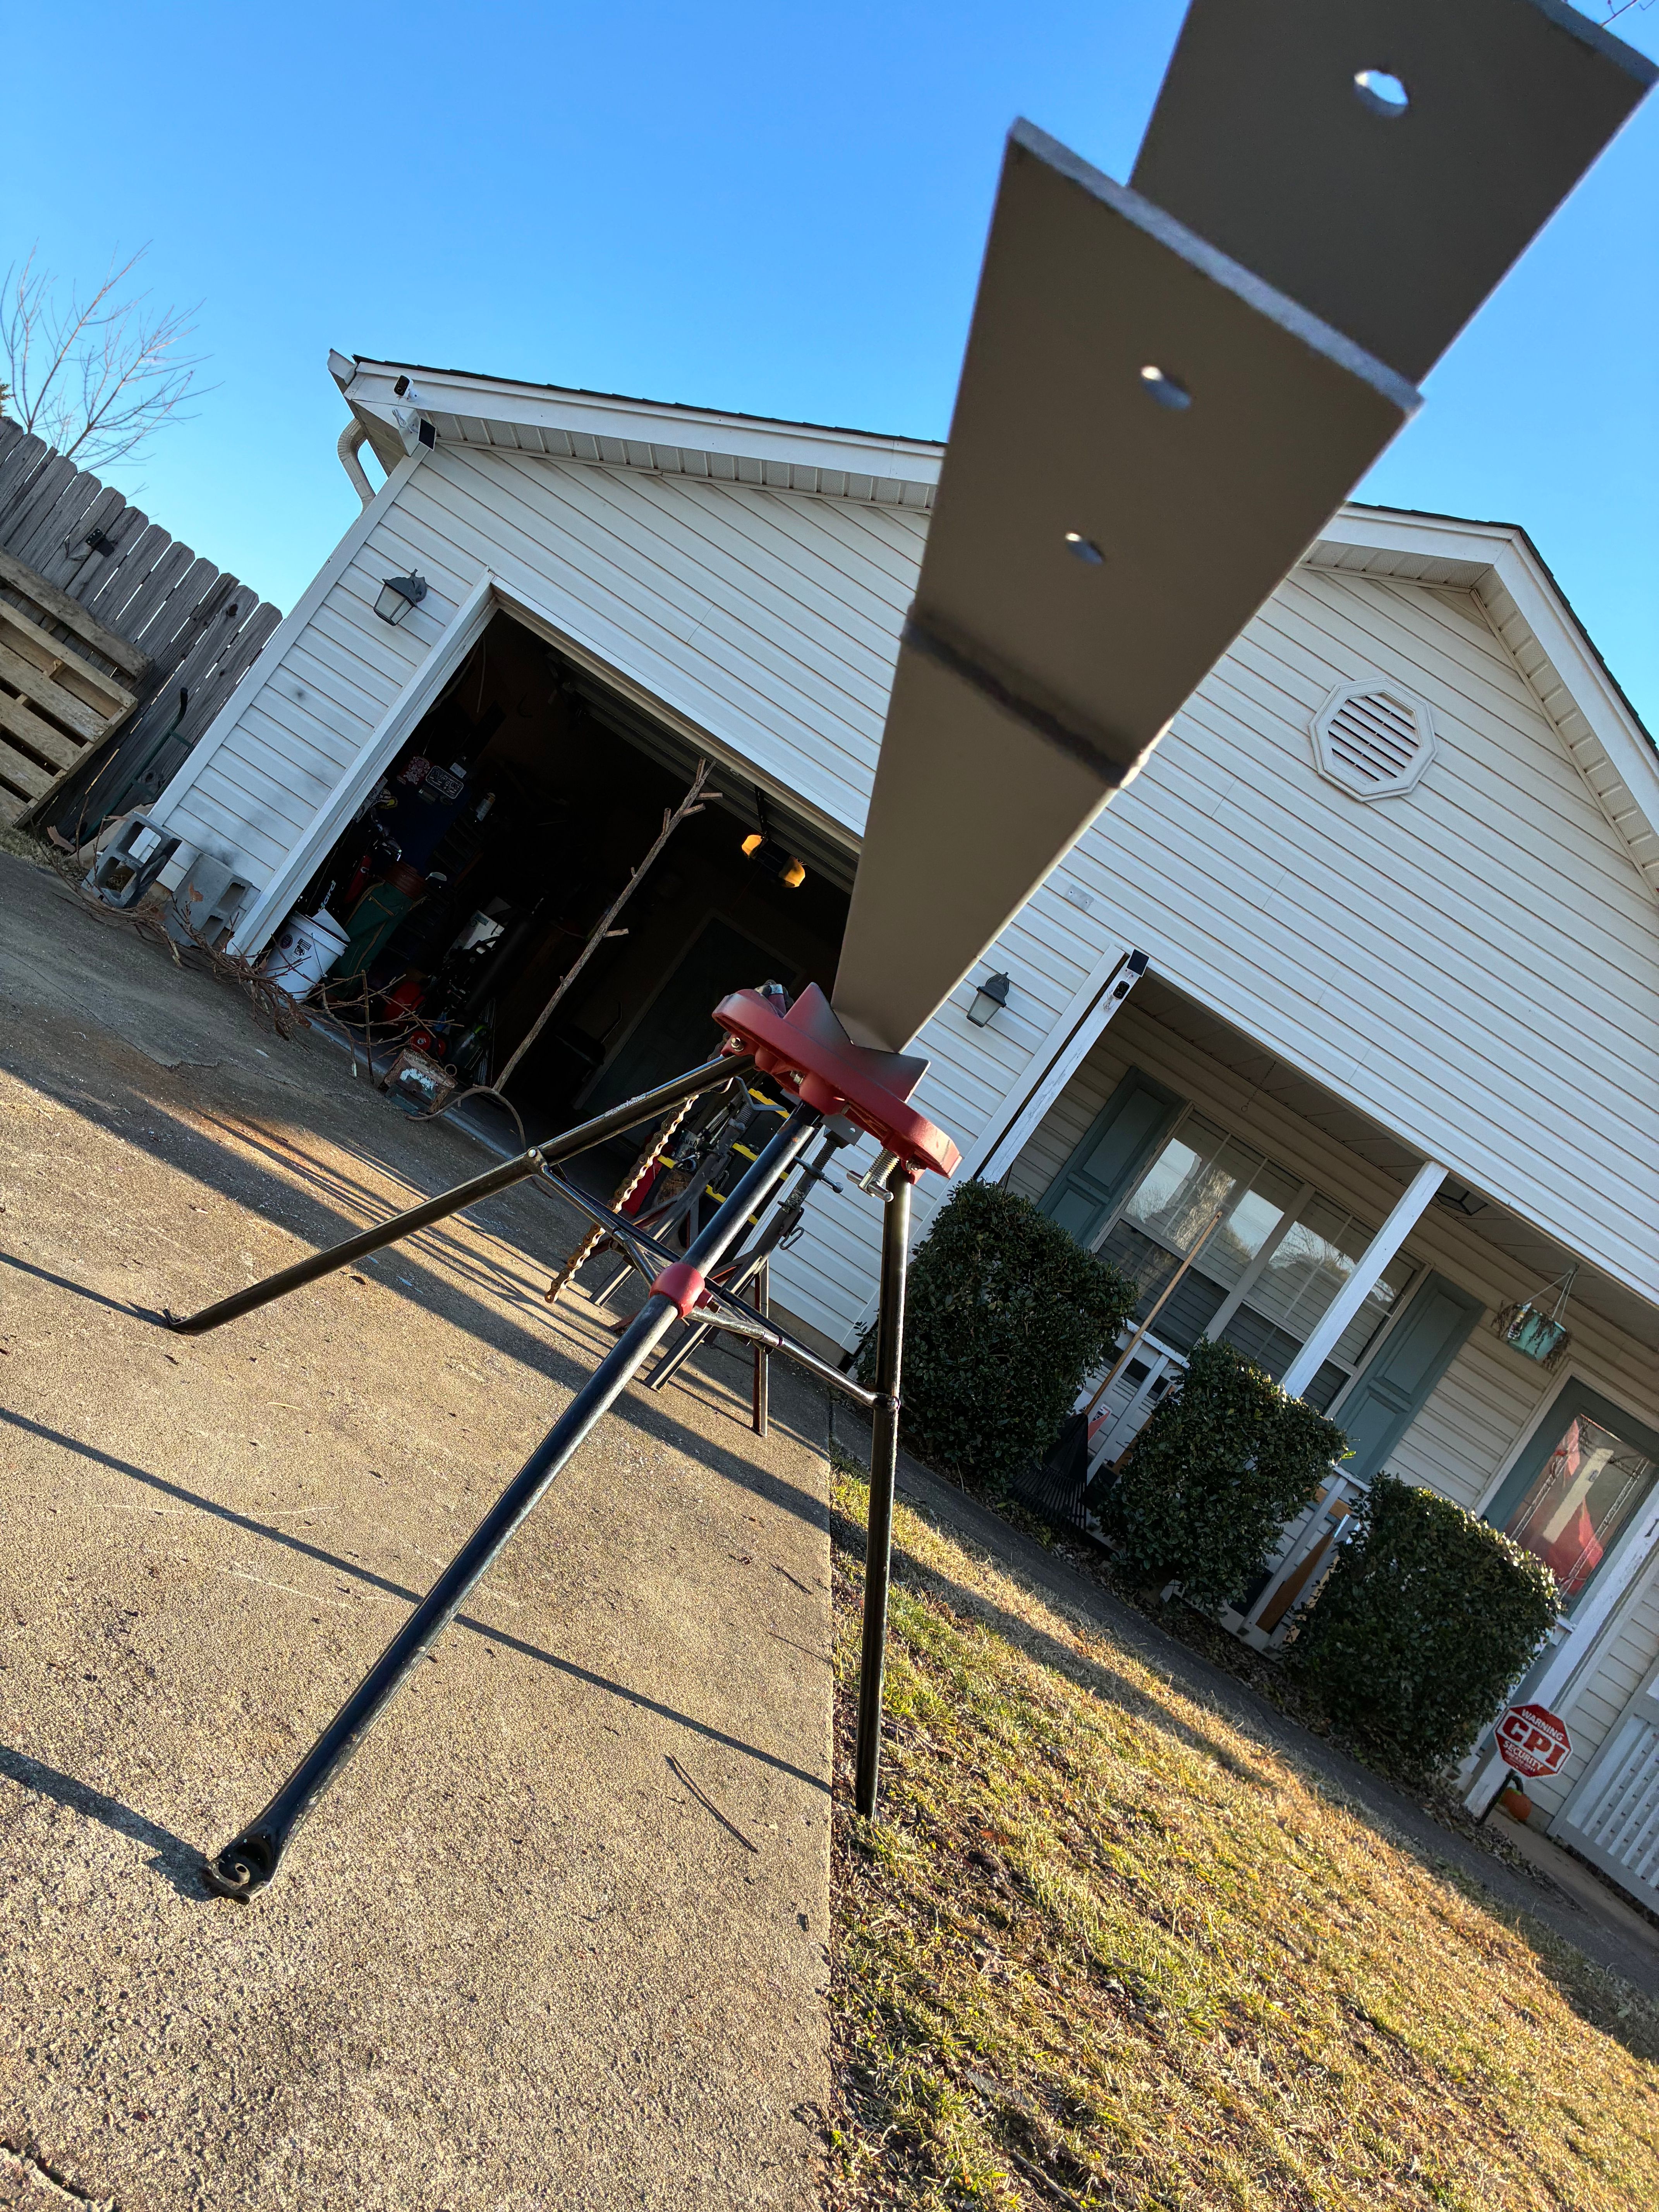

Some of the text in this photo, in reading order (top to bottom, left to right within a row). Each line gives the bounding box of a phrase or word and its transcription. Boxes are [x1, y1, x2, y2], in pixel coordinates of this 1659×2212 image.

[1522, 1709, 1564, 1741] WARNING
[1503, 1716, 1565, 1767] CPI
[1503, 1741, 1544, 1771] SECURITY
